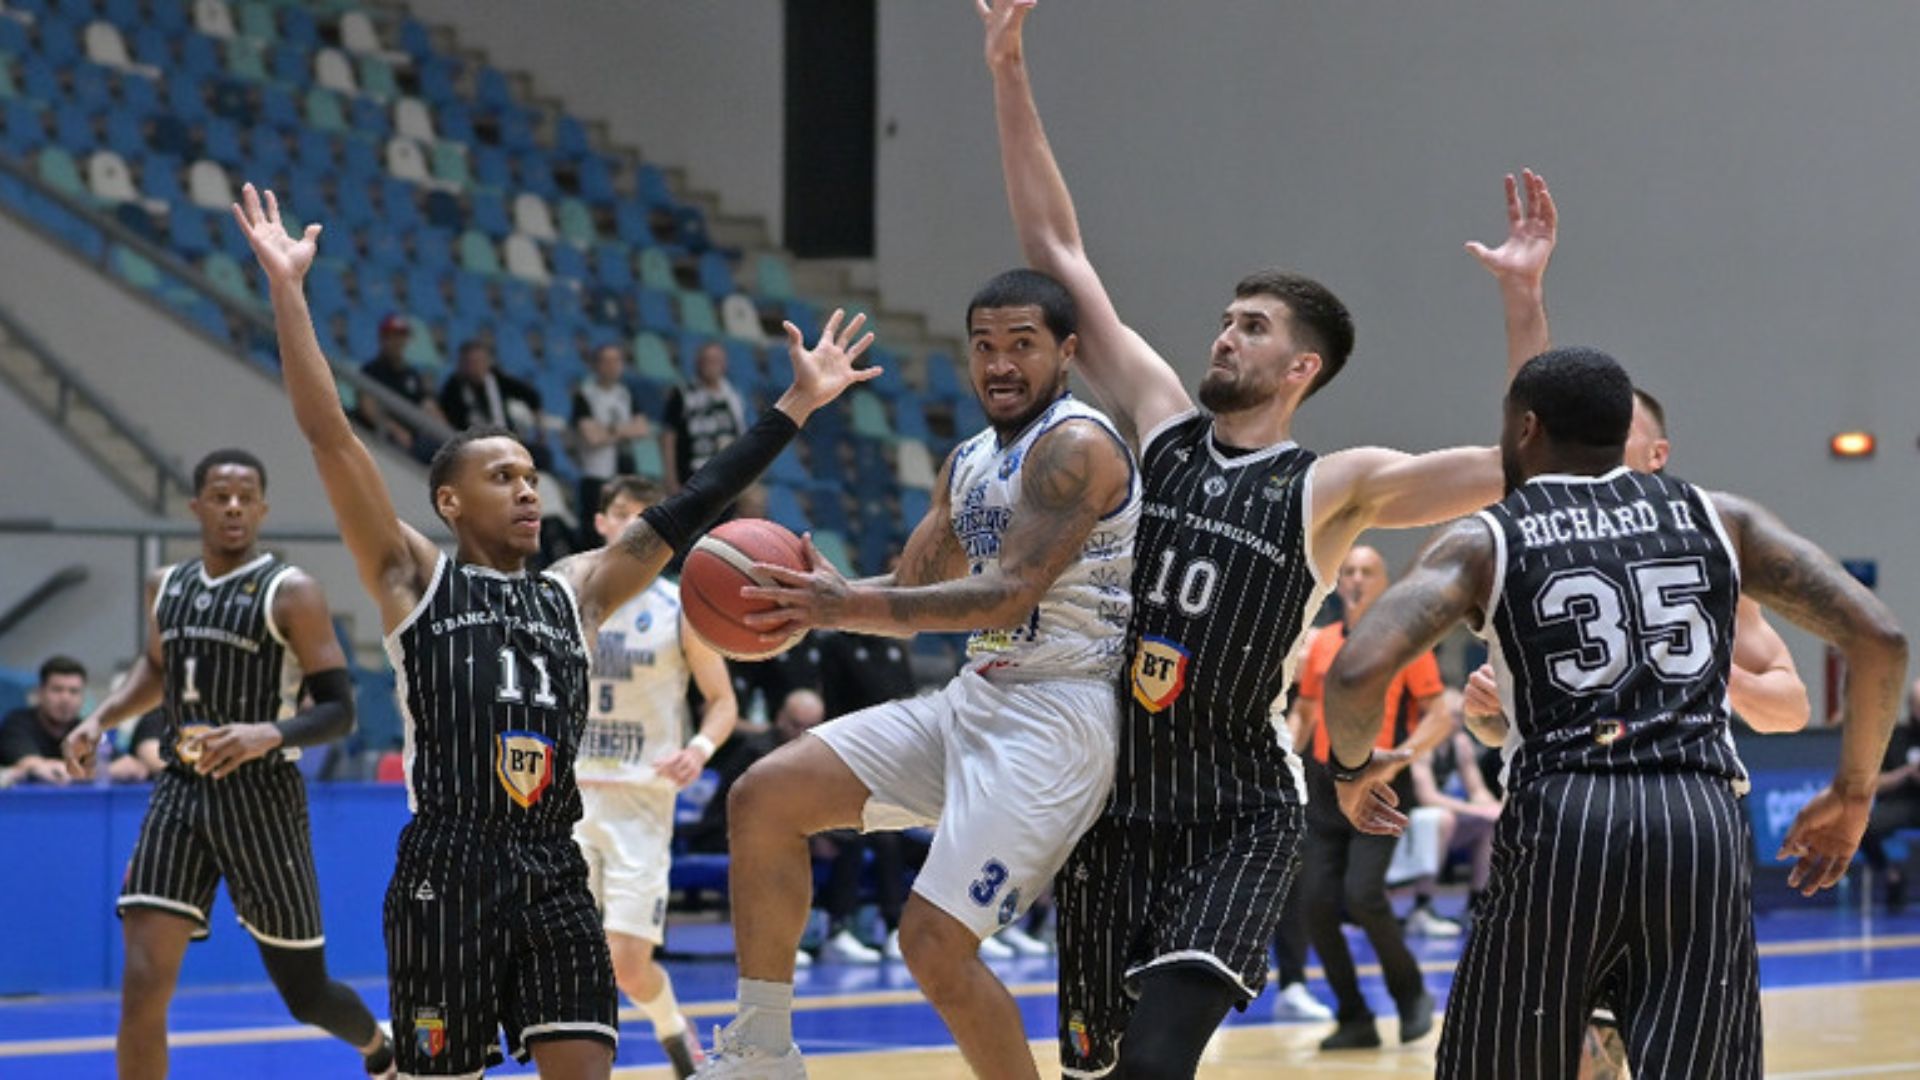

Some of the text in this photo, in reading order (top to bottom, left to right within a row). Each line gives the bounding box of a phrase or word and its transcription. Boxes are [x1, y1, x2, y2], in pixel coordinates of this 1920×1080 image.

[1517, 499, 1697, 548] RICHARD II
[1147, 547, 1221, 620] 10
[1532, 555, 1718, 697] 35
[181, 656, 200, 702] 1
[497, 647, 557, 711] 11
[1142, 651, 1175, 681] BT
[598, 683, 613, 713] 5
[510, 748, 543, 775] BT
